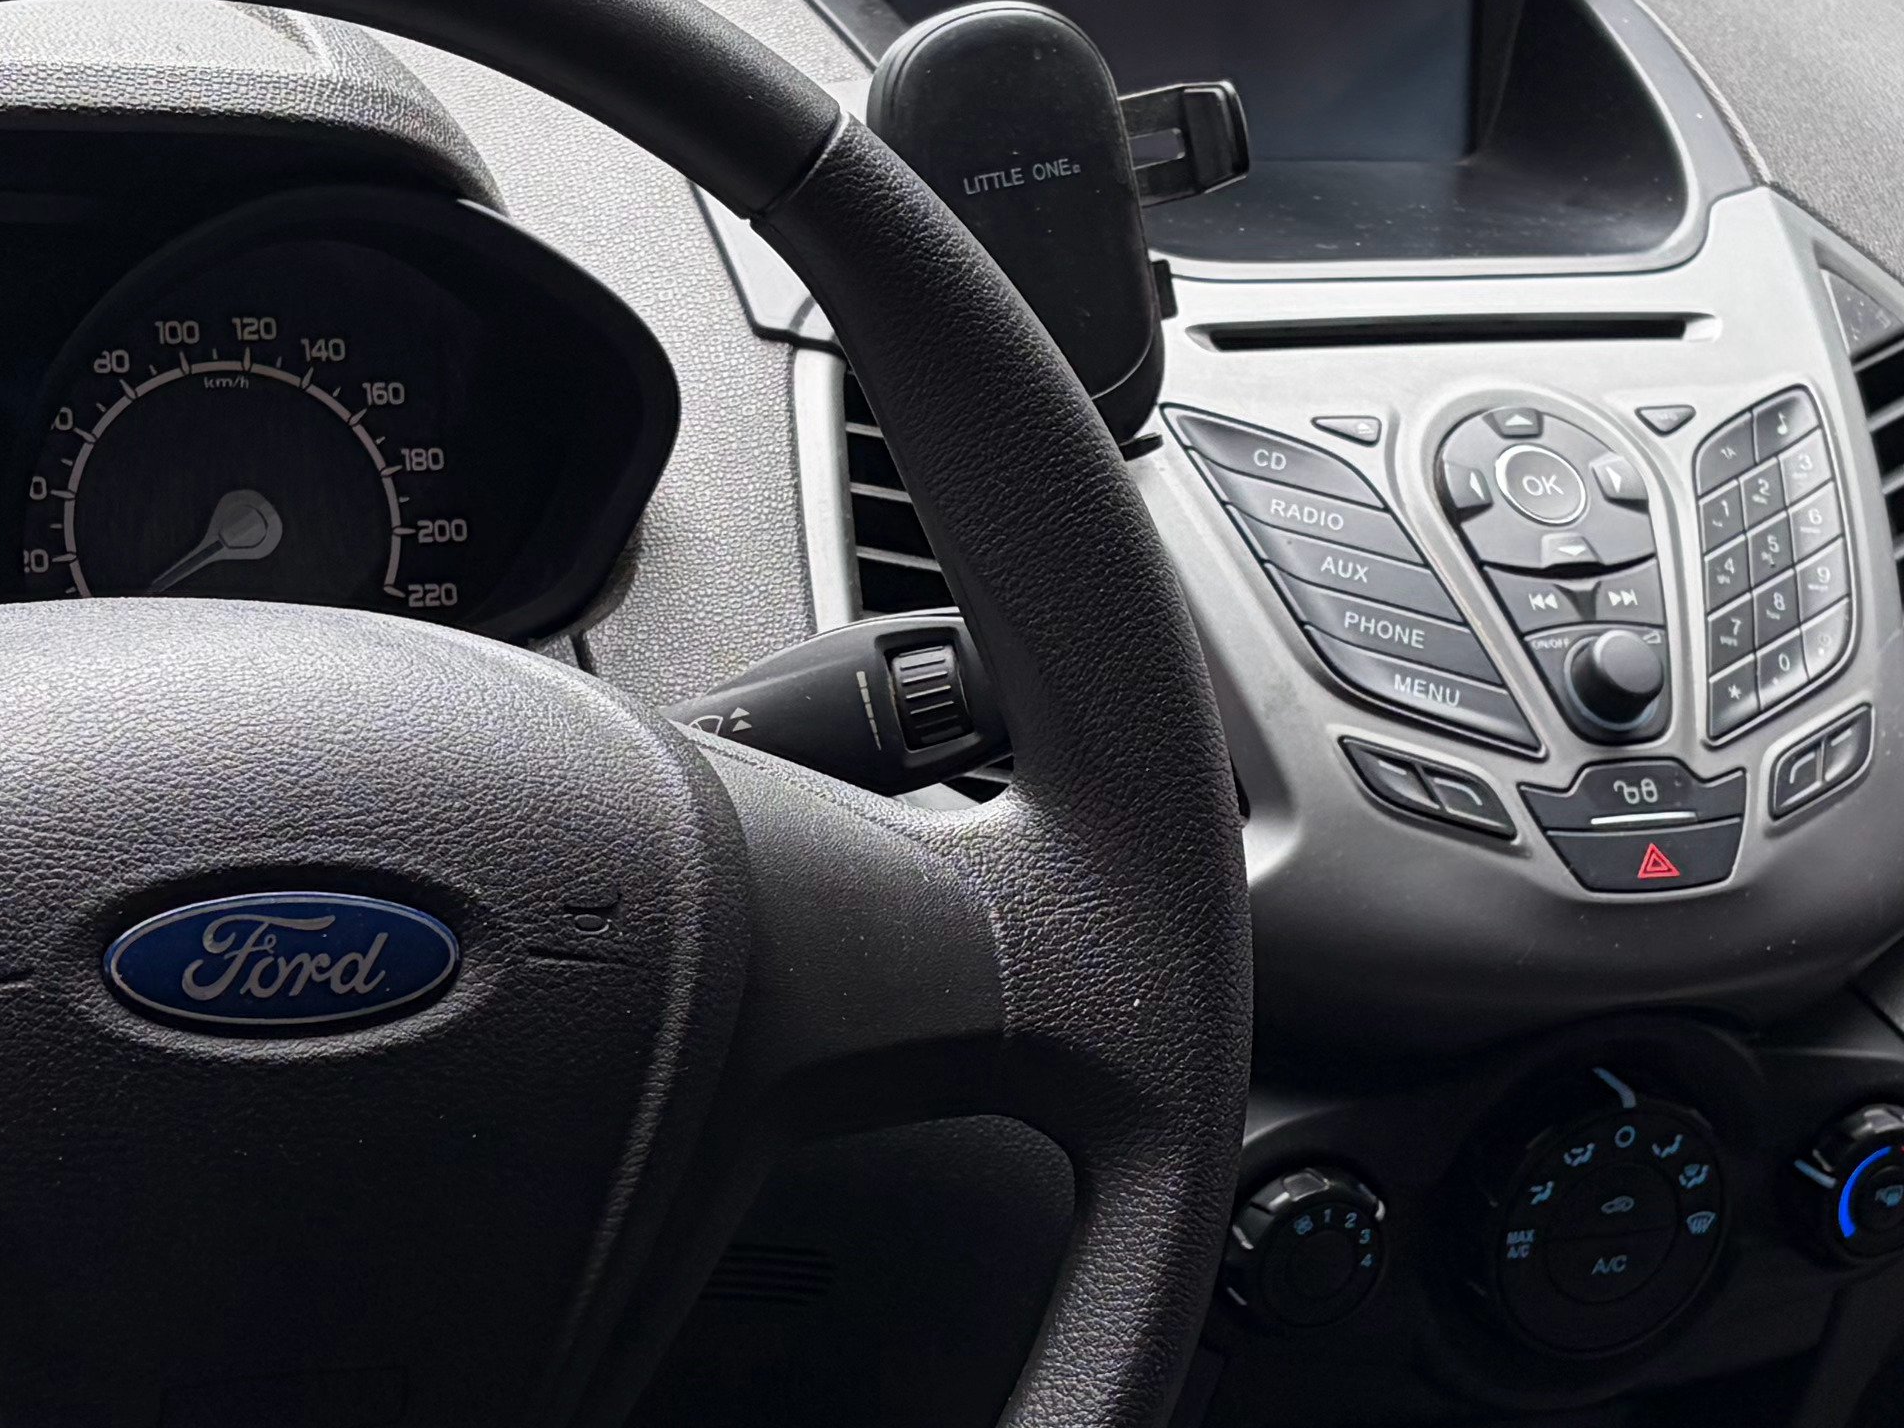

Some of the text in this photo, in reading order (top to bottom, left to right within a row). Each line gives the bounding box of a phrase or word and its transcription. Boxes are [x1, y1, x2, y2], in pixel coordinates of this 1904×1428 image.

[963, 158, 1072, 195] LITTLE ONE
[155, 320, 200, 345] 100
[232, 317, 278, 341] 120
[300, 338, 346, 362] 140
[203, 374, 250, 390] km/h
[362, 381, 406, 406] 160
[401, 447, 445, 472] 180
[1253, 448, 1287, 471] CD
[1798, 453, 1813, 471] 3
[1521, 474, 1565, 497] OK
[1757, 478, 1771, 496] 2
[1270, 498, 1345, 532] RADIO
[1807, 508, 1823, 525] 6
[416, 519, 469, 544] 200
[1767, 534, 1780, 553] 5
[1320, 556, 1370, 584] AUX
[1723, 556, 1736, 575] 4
[1816, 565, 1831, 584] 9
[407, 583, 459, 608] 220
[1772, 591, 1786, 612] 8
[1343, 611, 1426, 650] PHONE
[1730, 617, 1743, 636] 7
[1777, 652, 1791, 672] 0
[1394, 673, 1461, 708] MENU
[180, 913, 388, 1001] Ford
[1324, 1208, 1332, 1223] 1
[1344, 1212, 1358, 1228] 2
[1359, 1228, 1372, 1245] 3
[1506, 1229, 1536, 1245] MAX
[1360, 1253, 1373, 1268] 4
[1506, 1244, 1531, 1259] A/C
[1591, 1254, 1628, 1275] A/C
